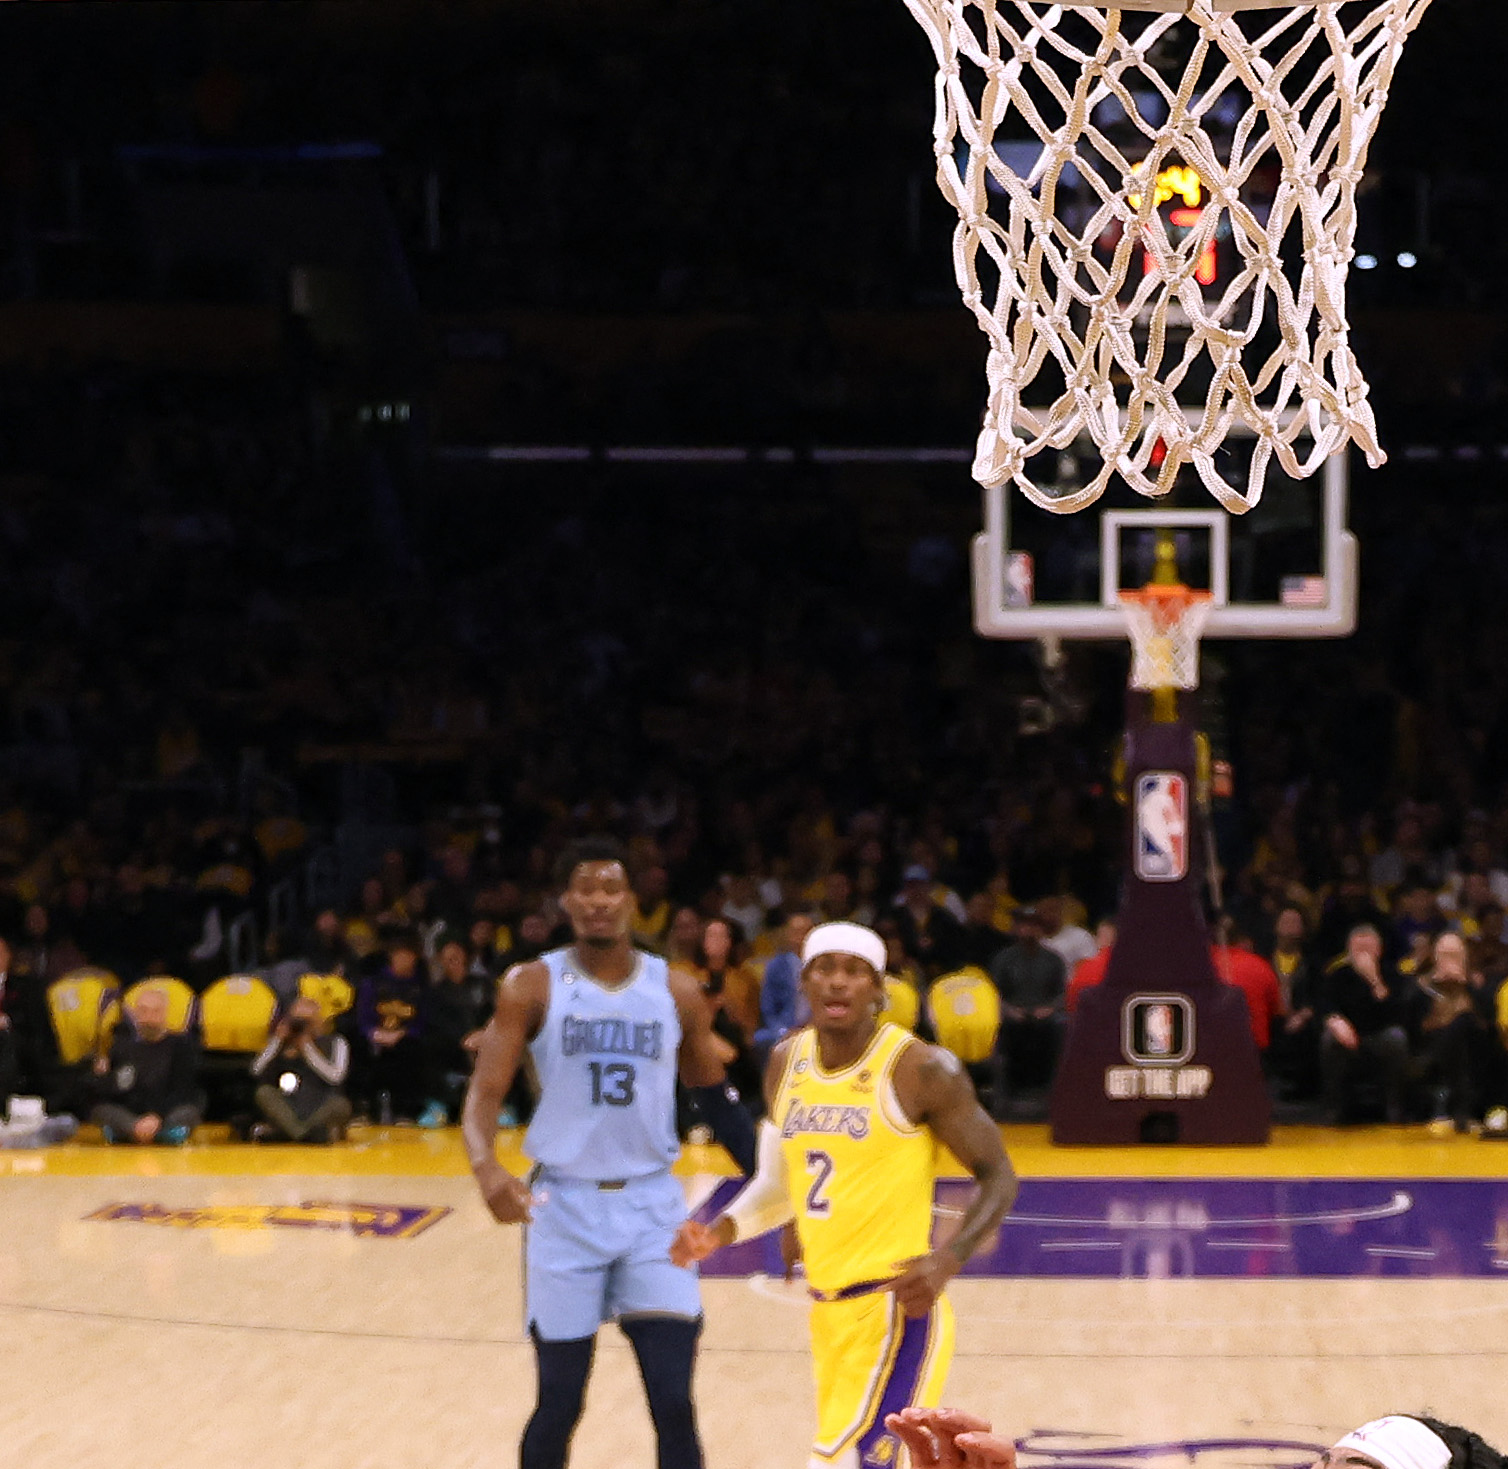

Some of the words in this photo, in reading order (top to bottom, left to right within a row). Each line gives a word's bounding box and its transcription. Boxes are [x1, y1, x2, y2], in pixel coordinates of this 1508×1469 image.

[588, 1061, 636, 1107] 13
[781, 1098, 871, 1140] LAKERS
[805, 1150, 836, 1219] 2
